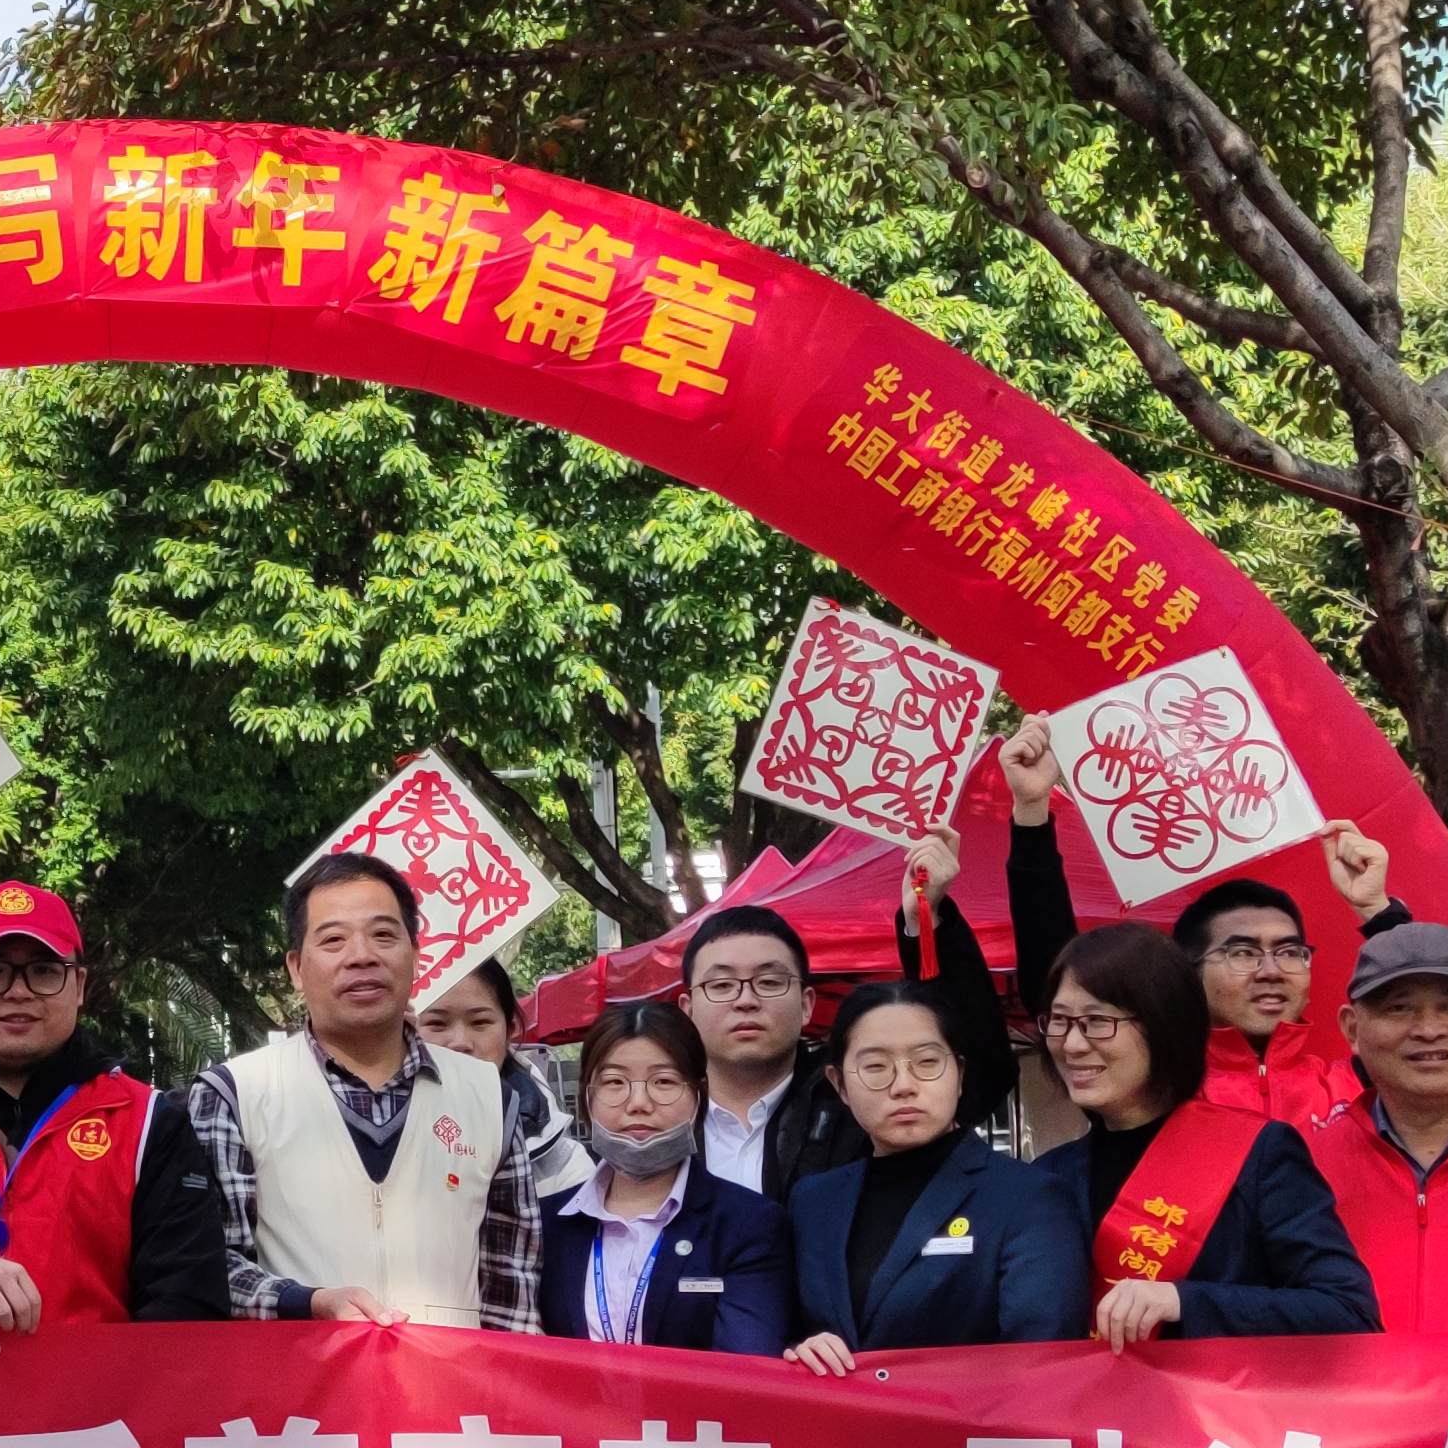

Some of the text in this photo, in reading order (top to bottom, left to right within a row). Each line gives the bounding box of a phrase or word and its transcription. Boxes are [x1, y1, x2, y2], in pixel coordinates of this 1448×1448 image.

[826, 411, 1165, 680] 中国工商银行福州闽都支行
[863, 362, 1201, 633] 华大街道龙峰社区党委
